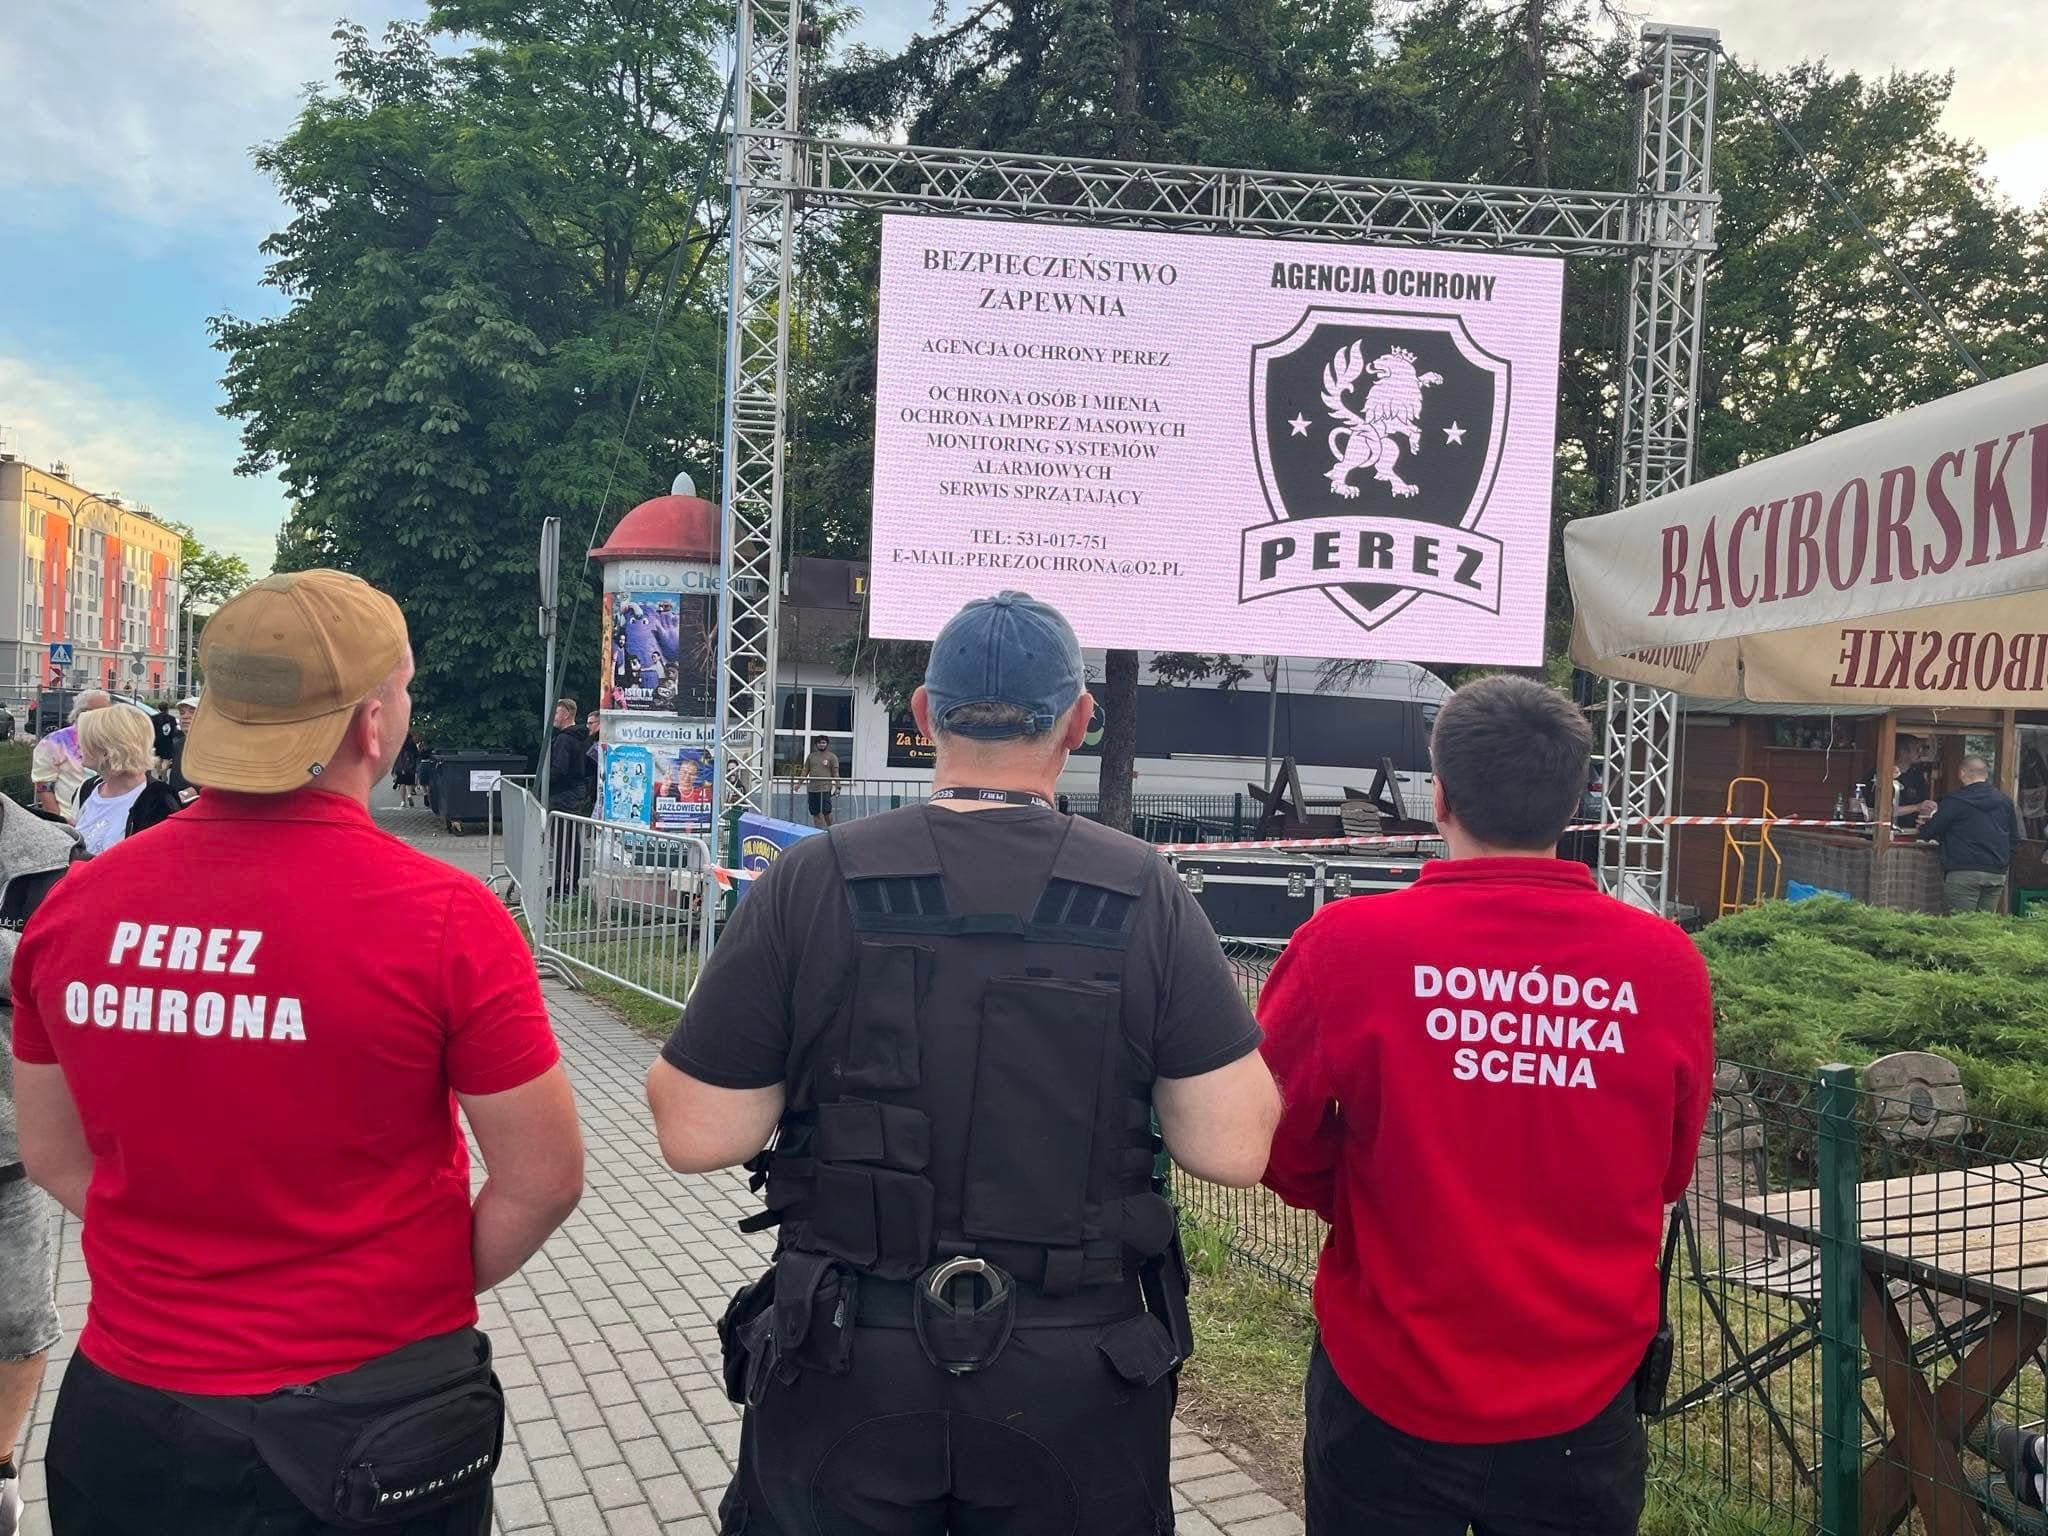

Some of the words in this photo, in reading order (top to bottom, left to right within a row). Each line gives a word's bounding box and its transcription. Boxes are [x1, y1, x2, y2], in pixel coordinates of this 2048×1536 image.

[923, 249, 1178, 286] BEZPIECZEŃSTWO
[1271, 262, 1376, 294] AGENCJA
[1383, 268, 1496, 301] OCHRONY
[979, 287, 1126, 318] ZAPEWNIA
[921, 338, 1009, 358] AGENCJA
[1013, 343, 1107, 363] OCHRONY
[1112, 349, 1171, 367] PEREZ
[929, 385, 1022, 406] OCHRONA
[1027, 388, 1077, 409] OSÓB
[1081, 394, 1088, 409] I
[1093, 395, 1161, 413] MIENIA
[900, 408, 994, 427] OCHRONA
[999, 413, 1071, 432] IMPREZ
[1075, 417, 1186, 438] MASOWYCH
[926, 432, 1050, 454] MONITORING
[1054, 439, 1160, 460] SYSTEMÓW
[972, 460, 1112, 480] ALARMOWYCH
[939, 480, 1009, 499] SERWIS
[1013, 484, 1144, 508] SPRZĄTAJĄCY
[970, 529, 1012, 546] TEL:
[1016, 531, 1108, 550] 531-017-751
[1259, 530, 1485, 592] PEREZ
[624, 569, 671, 588] kino
[621, 726, 692, 741] wydarzenia
[896, 732, 912, 746] Za
[109, 921, 263, 974] PEREZ
[1414, 965, 1638, 1014] DOWÓDCA
[65, 981, 307, 1041] OCHRONA
[1426, 1007, 1625, 1054] ODCINKA
[1453, 1048, 1597, 1089] SCENA
